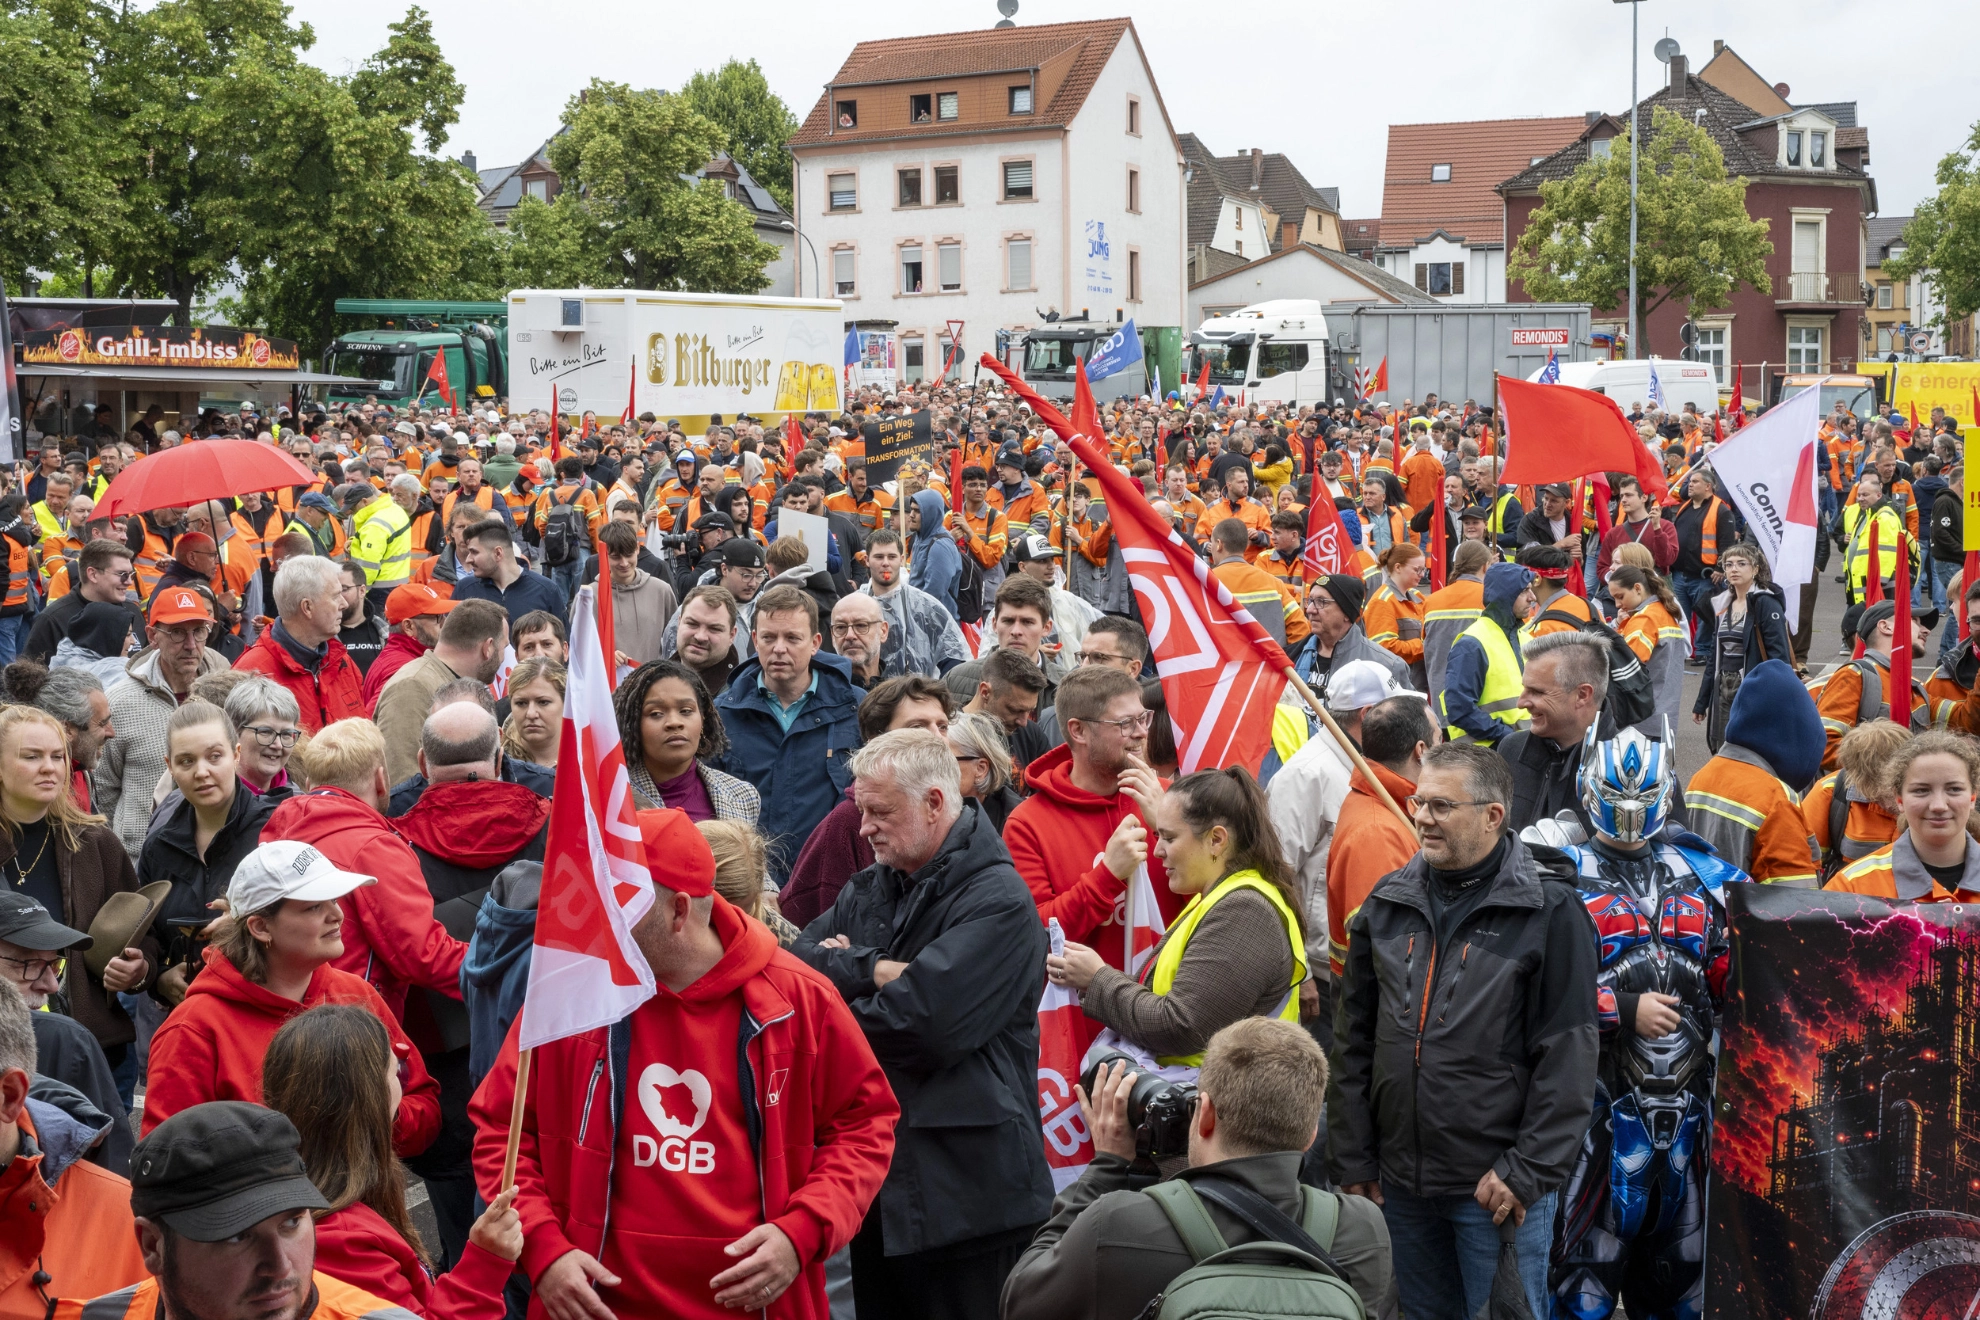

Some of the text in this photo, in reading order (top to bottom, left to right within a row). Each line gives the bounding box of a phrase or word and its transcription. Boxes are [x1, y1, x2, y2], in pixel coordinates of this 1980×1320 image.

[1088, 238, 1109, 258] JUNG
[752, 325, 764, 338] Bit
[97, 336, 238, 360] Grill-Imbiss
[346, 343, 383, 351] SCHWINN
[530, 343, 606, 375] Bitte ein Bit
[673, 332, 771, 395] Bitburger
[879, 418, 915, 433] Ein Weg,
[881, 430, 914, 446] ein Ziel:
[866, 443, 931, 465] TRANSFORMATION
[633, 1134, 715, 1174] DGB
